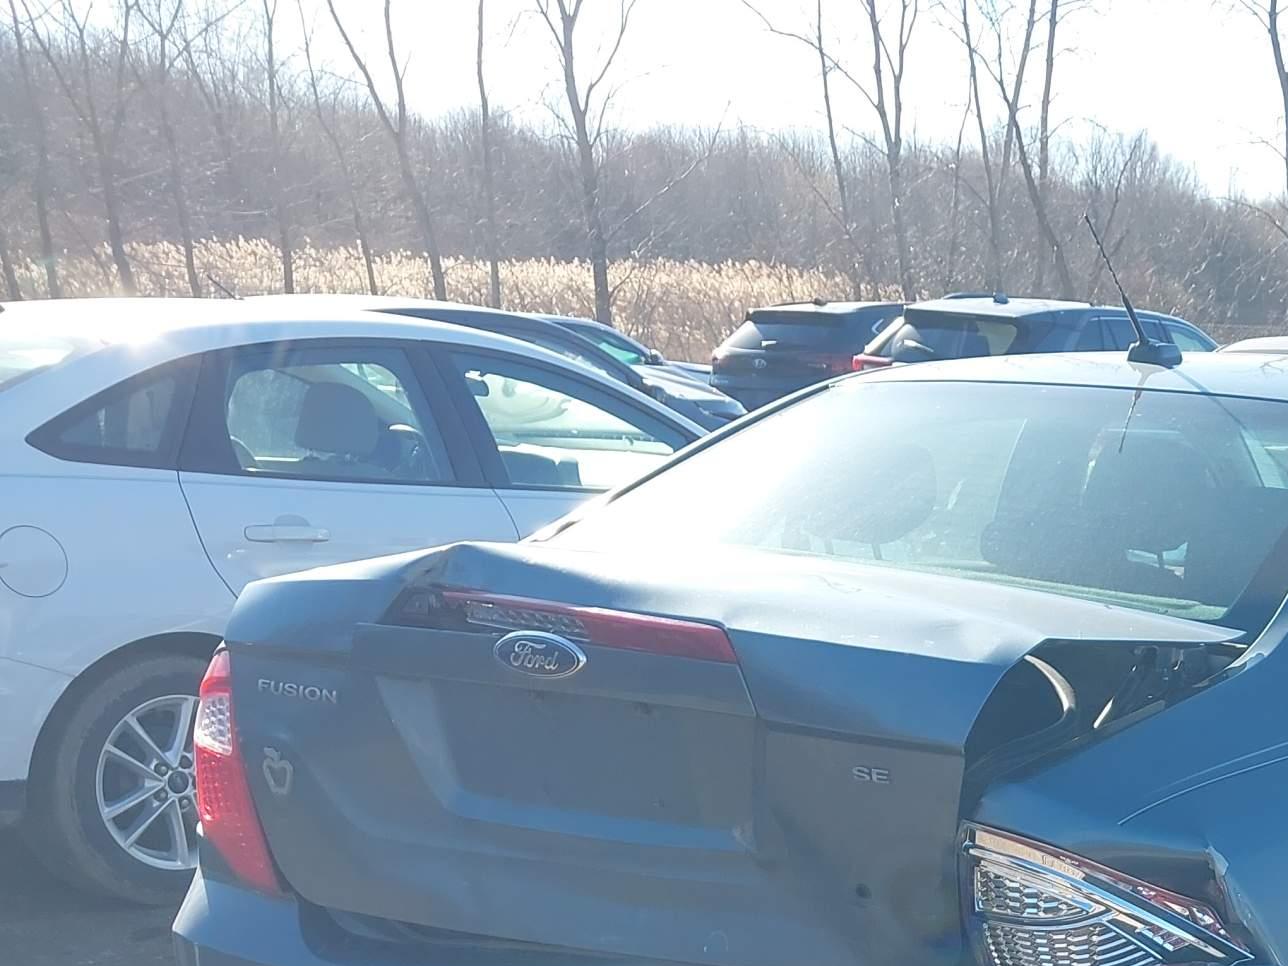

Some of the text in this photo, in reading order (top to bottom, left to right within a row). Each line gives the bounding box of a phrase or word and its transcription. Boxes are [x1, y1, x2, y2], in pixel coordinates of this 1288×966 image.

[509, 640, 559, 671] Ford
[257, 679, 337, 703] FUSION
[852, 766, 889, 784] SE
